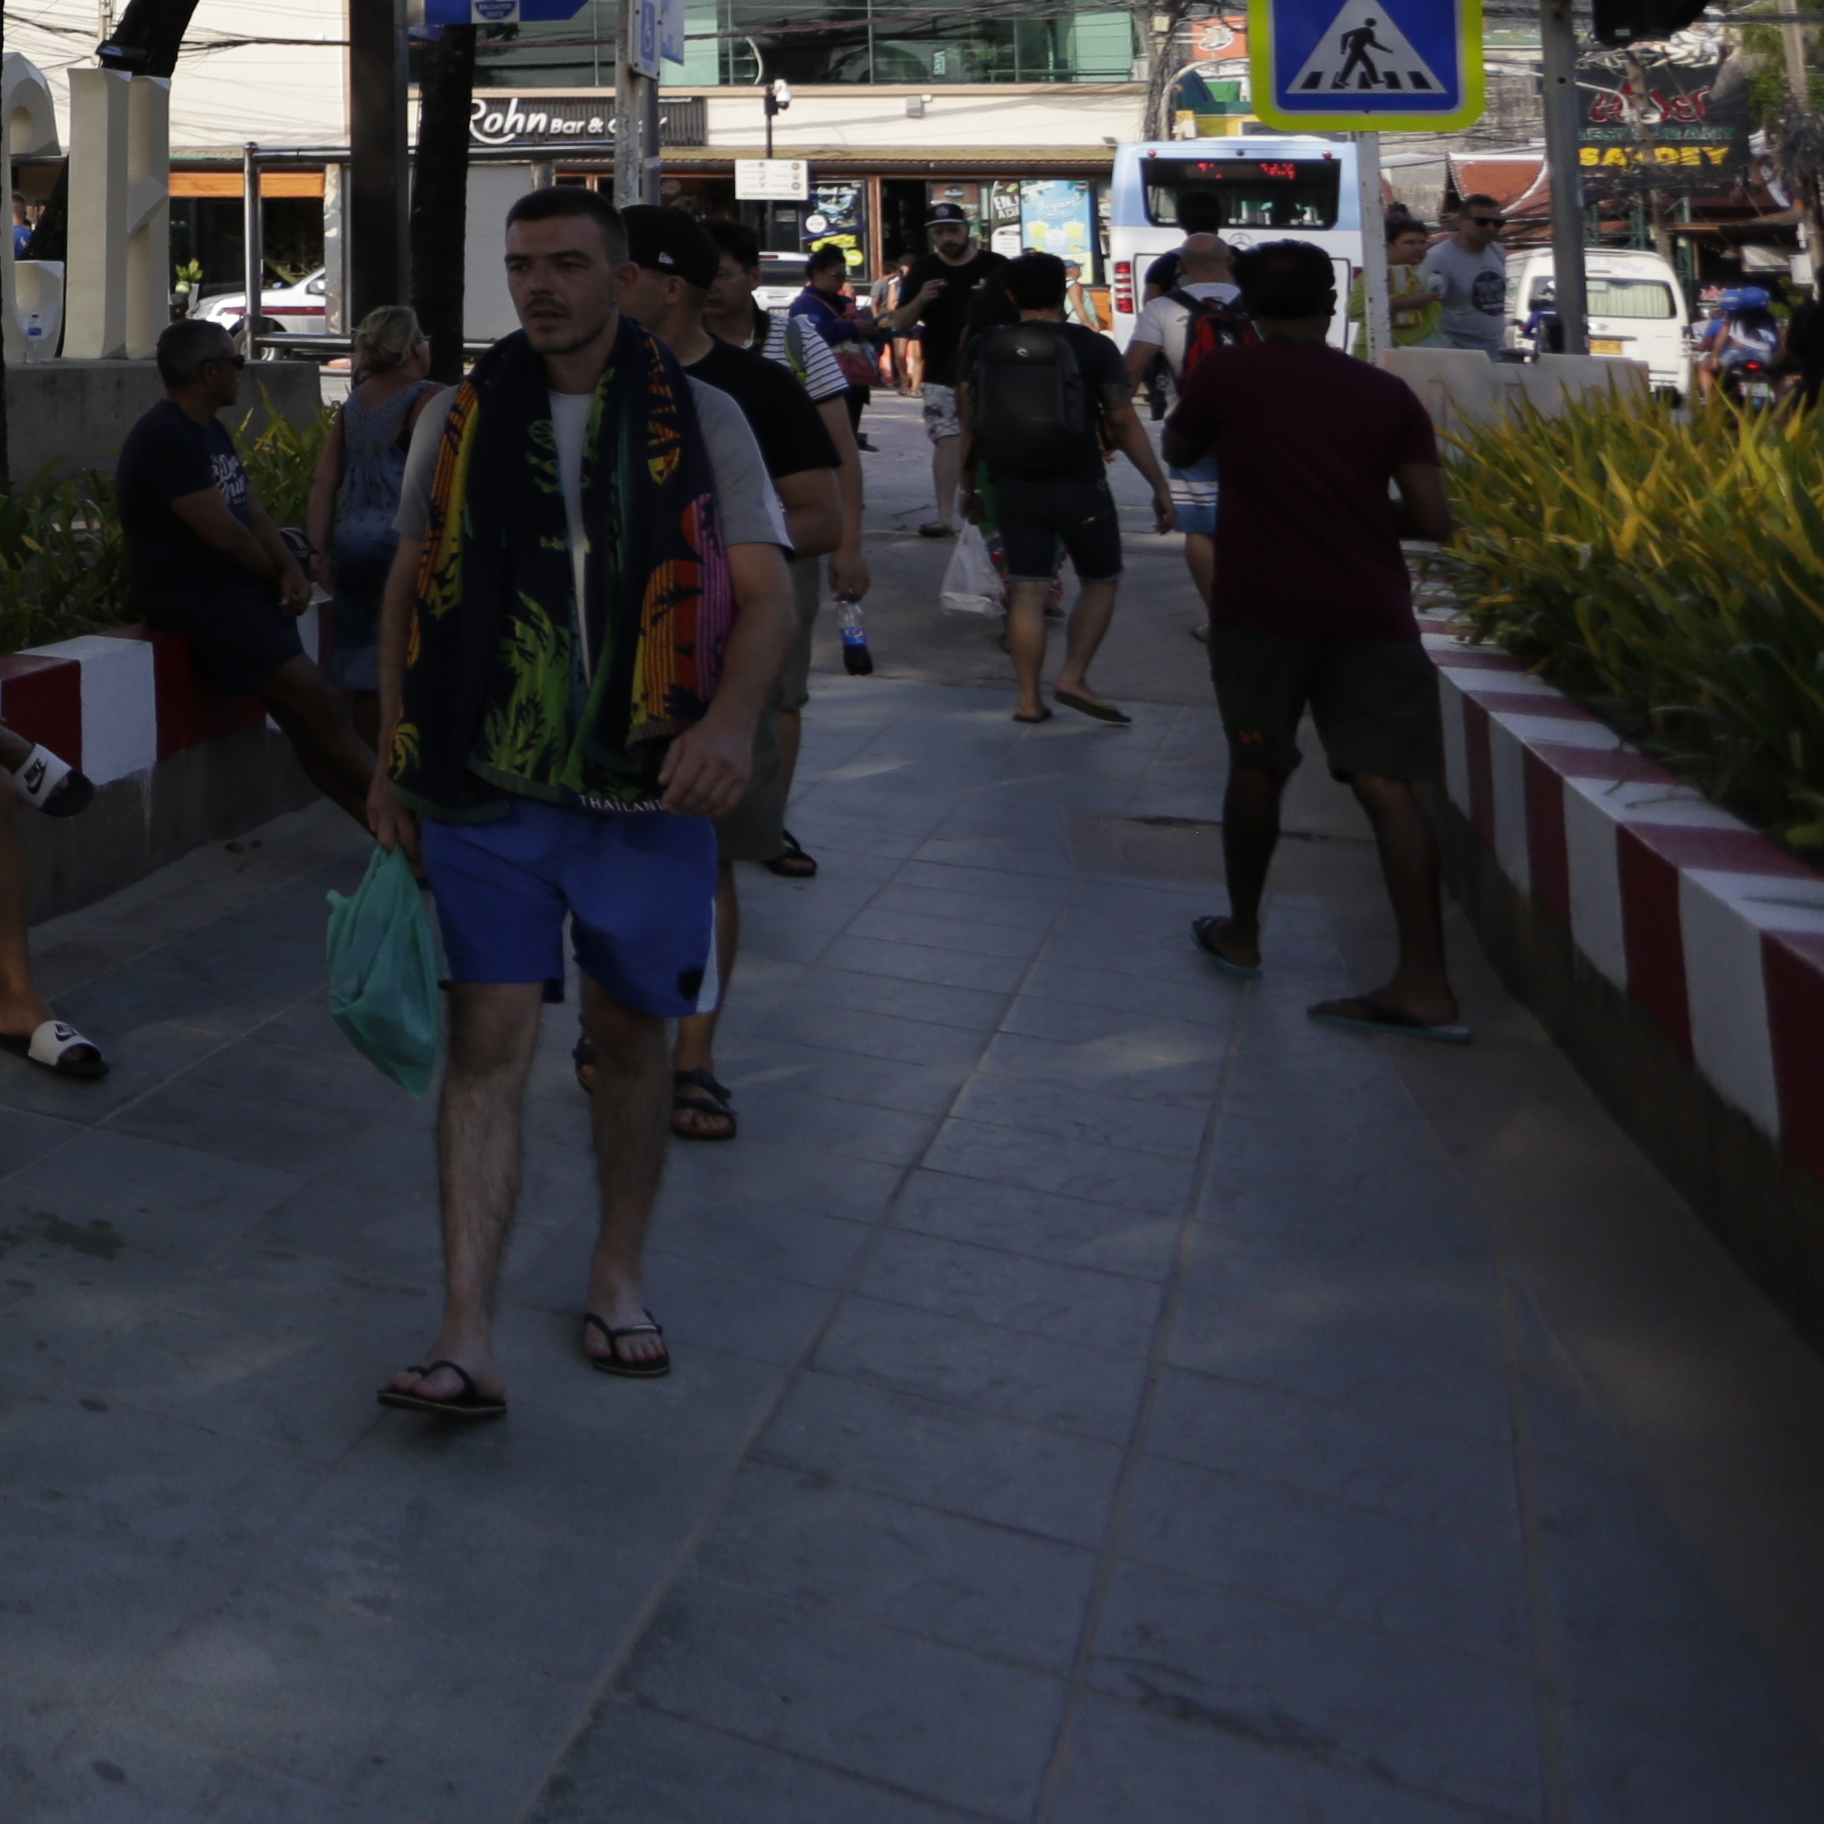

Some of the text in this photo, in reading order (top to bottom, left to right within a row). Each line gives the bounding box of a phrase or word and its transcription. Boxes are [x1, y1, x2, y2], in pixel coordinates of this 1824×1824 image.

[549, 117, 583, 134] Bar
[587, 117, 603, 134] &
[23, 758, 45, 784] NIKE
